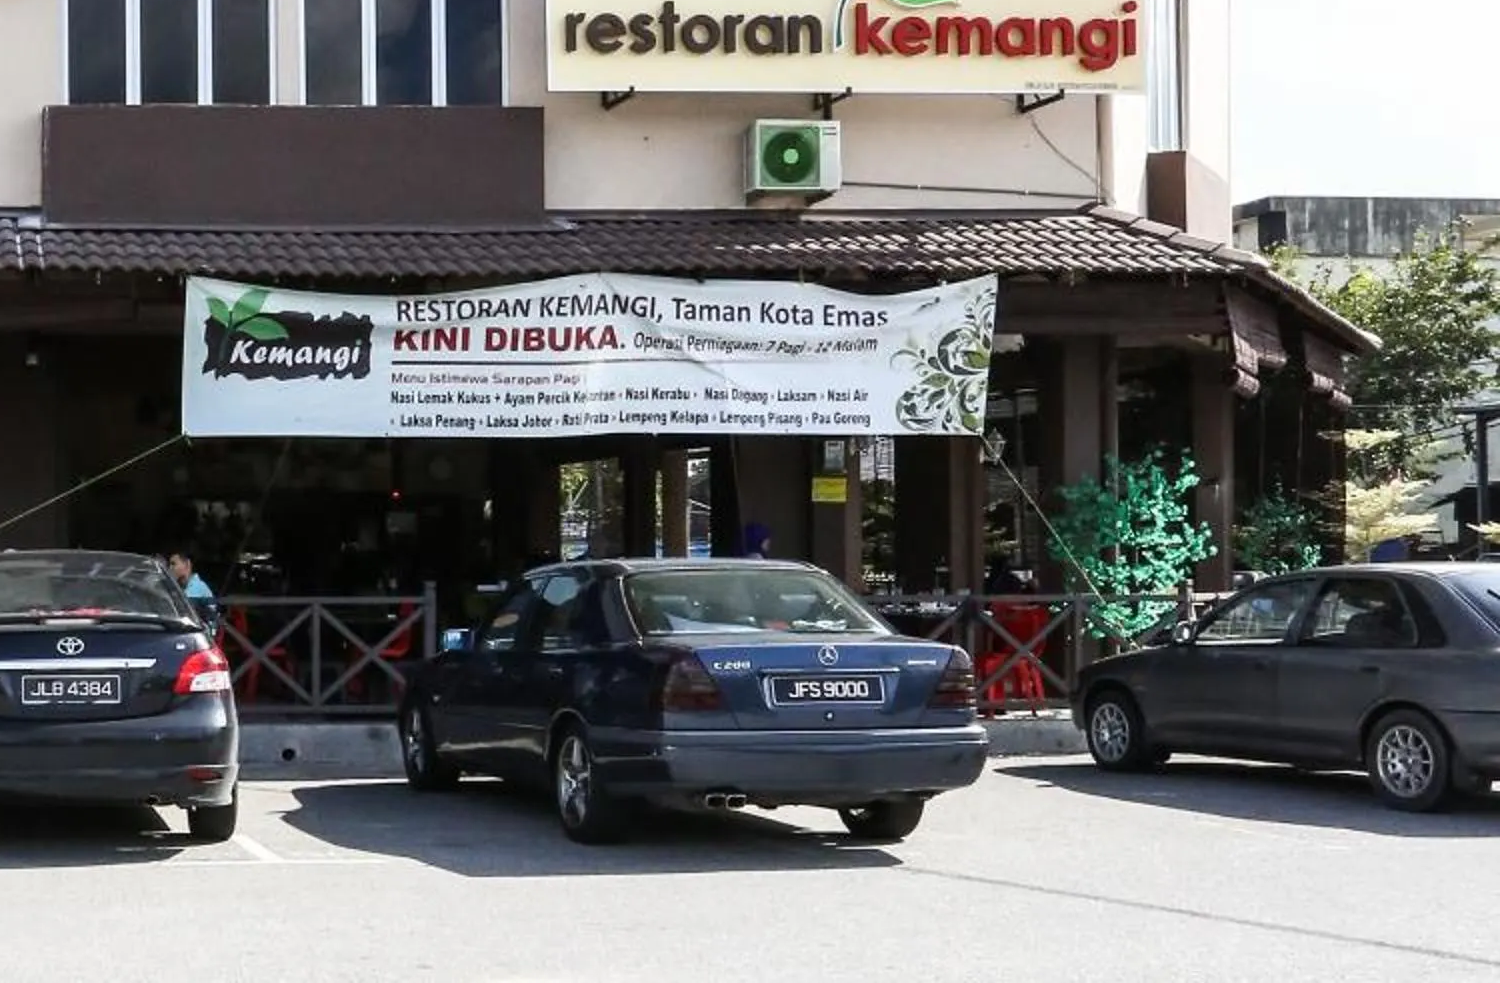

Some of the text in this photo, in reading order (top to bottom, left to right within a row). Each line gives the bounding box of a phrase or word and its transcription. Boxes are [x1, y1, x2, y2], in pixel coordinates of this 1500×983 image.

[564, 0, 1138, 72] restoran kemangi
[397, 294, 889, 327] RESTORAN KEMANGI, Taman Kota Emas
[393, 326, 470, 352] KINI
[484, 325, 625, 352] DIBUKA.
[777, 340, 804, 356] Pagi
[229, 339, 362, 371] Kemangi
[492, 372, 550, 386] Sarapan
[390, 391, 414, 404] Nasi
[418, 391, 453, 404] Lemak
[504, 391, 535, 407] Ayam
[626, 387, 649, 400] Nasi
[651, 387, 690, 400] Kerabu
[705, 387, 729, 400] Nasi
[827, 389, 850, 402] Nasi
[853, 389, 869, 402] Air
[401, 414, 432, 427] Laksa
[435, 414, 476, 430] Penang
[487, 414, 519, 427] Laksa
[620, 411, 667, 425] Lempeng
[670, 411, 709, 425] Kelapa
[30, 681, 112, 696] JLB 4384
[788, 680, 869, 698] JFS 9000
